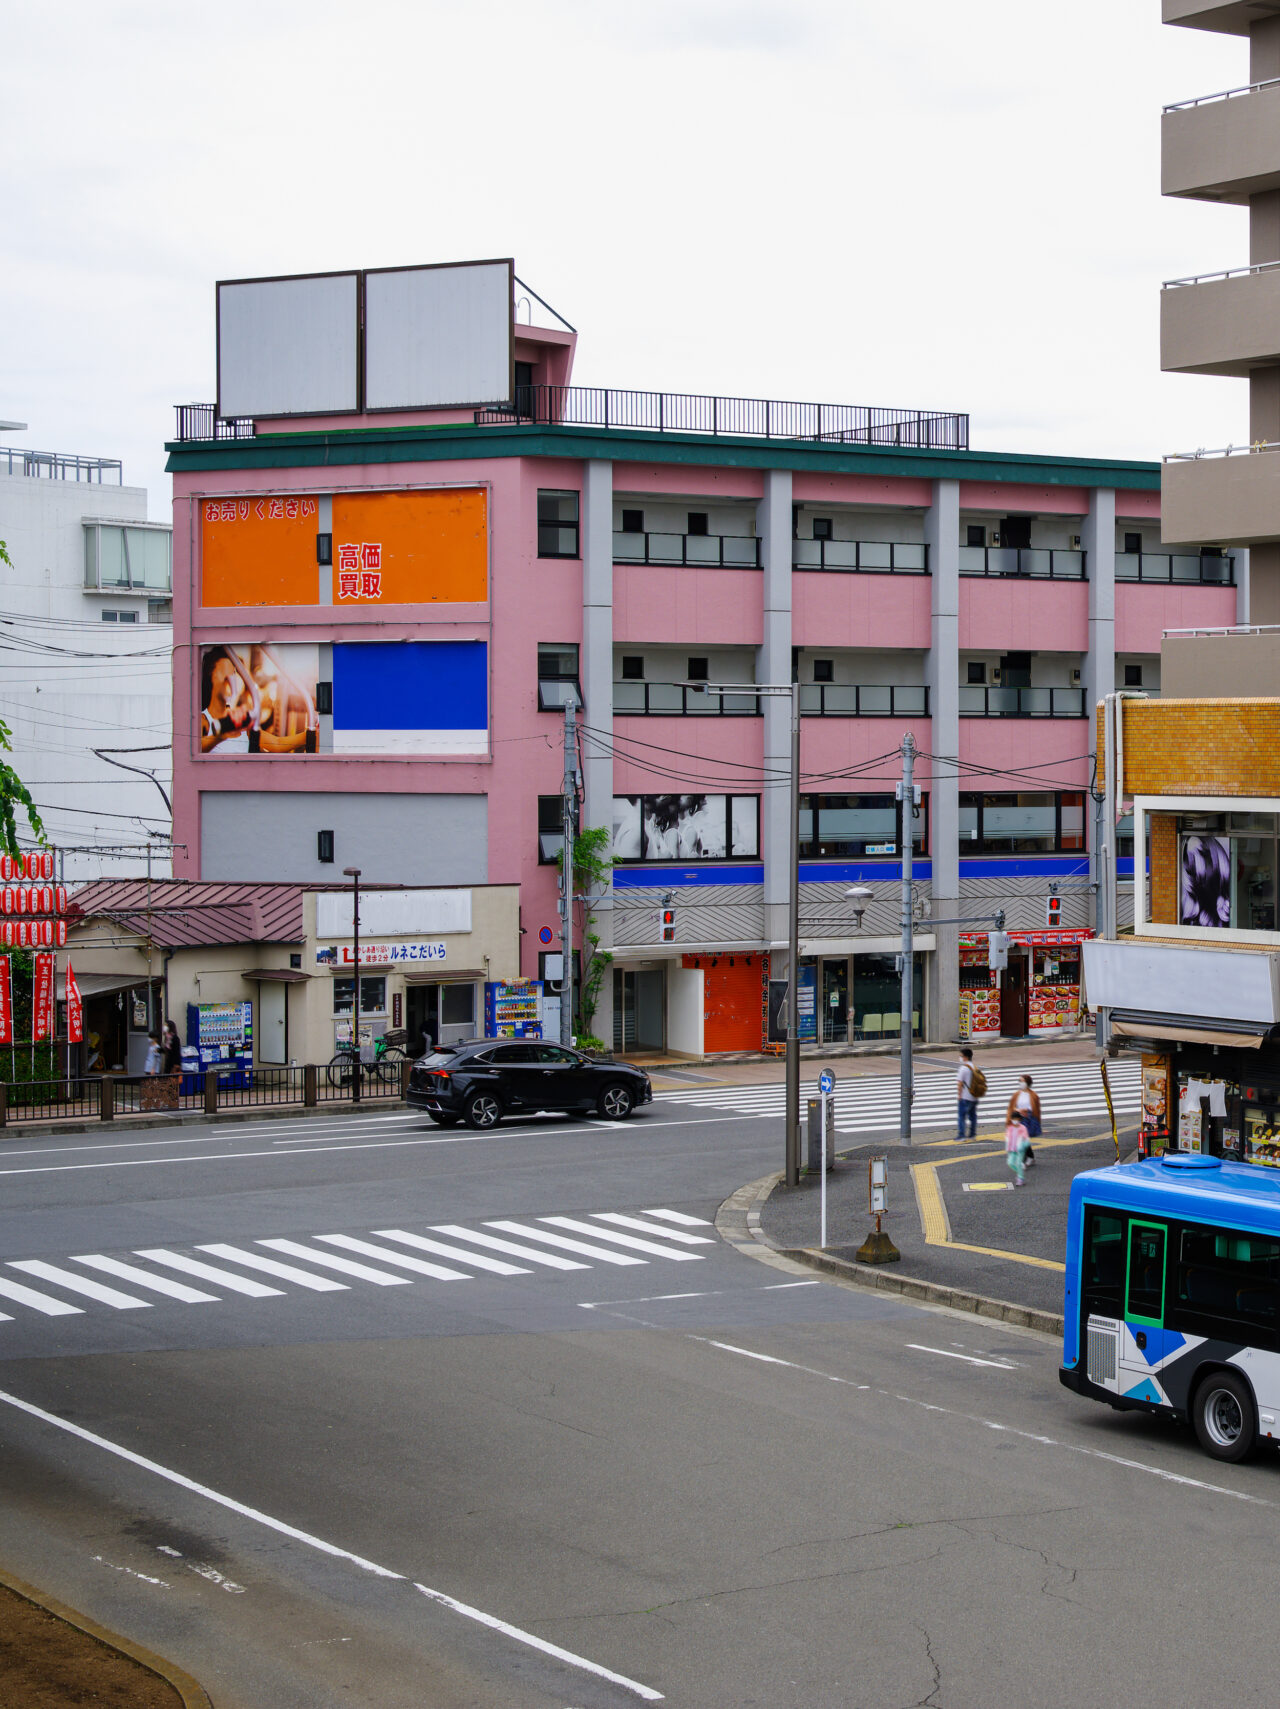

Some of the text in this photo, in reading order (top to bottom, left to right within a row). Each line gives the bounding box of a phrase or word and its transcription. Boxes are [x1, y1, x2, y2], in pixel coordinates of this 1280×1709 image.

[206, 499, 315, 521] お売りください
[338, 543, 382, 570] 高価
[338, 572, 382, 598] 買取
[390, 943, 446, 960] ルネこだいら
